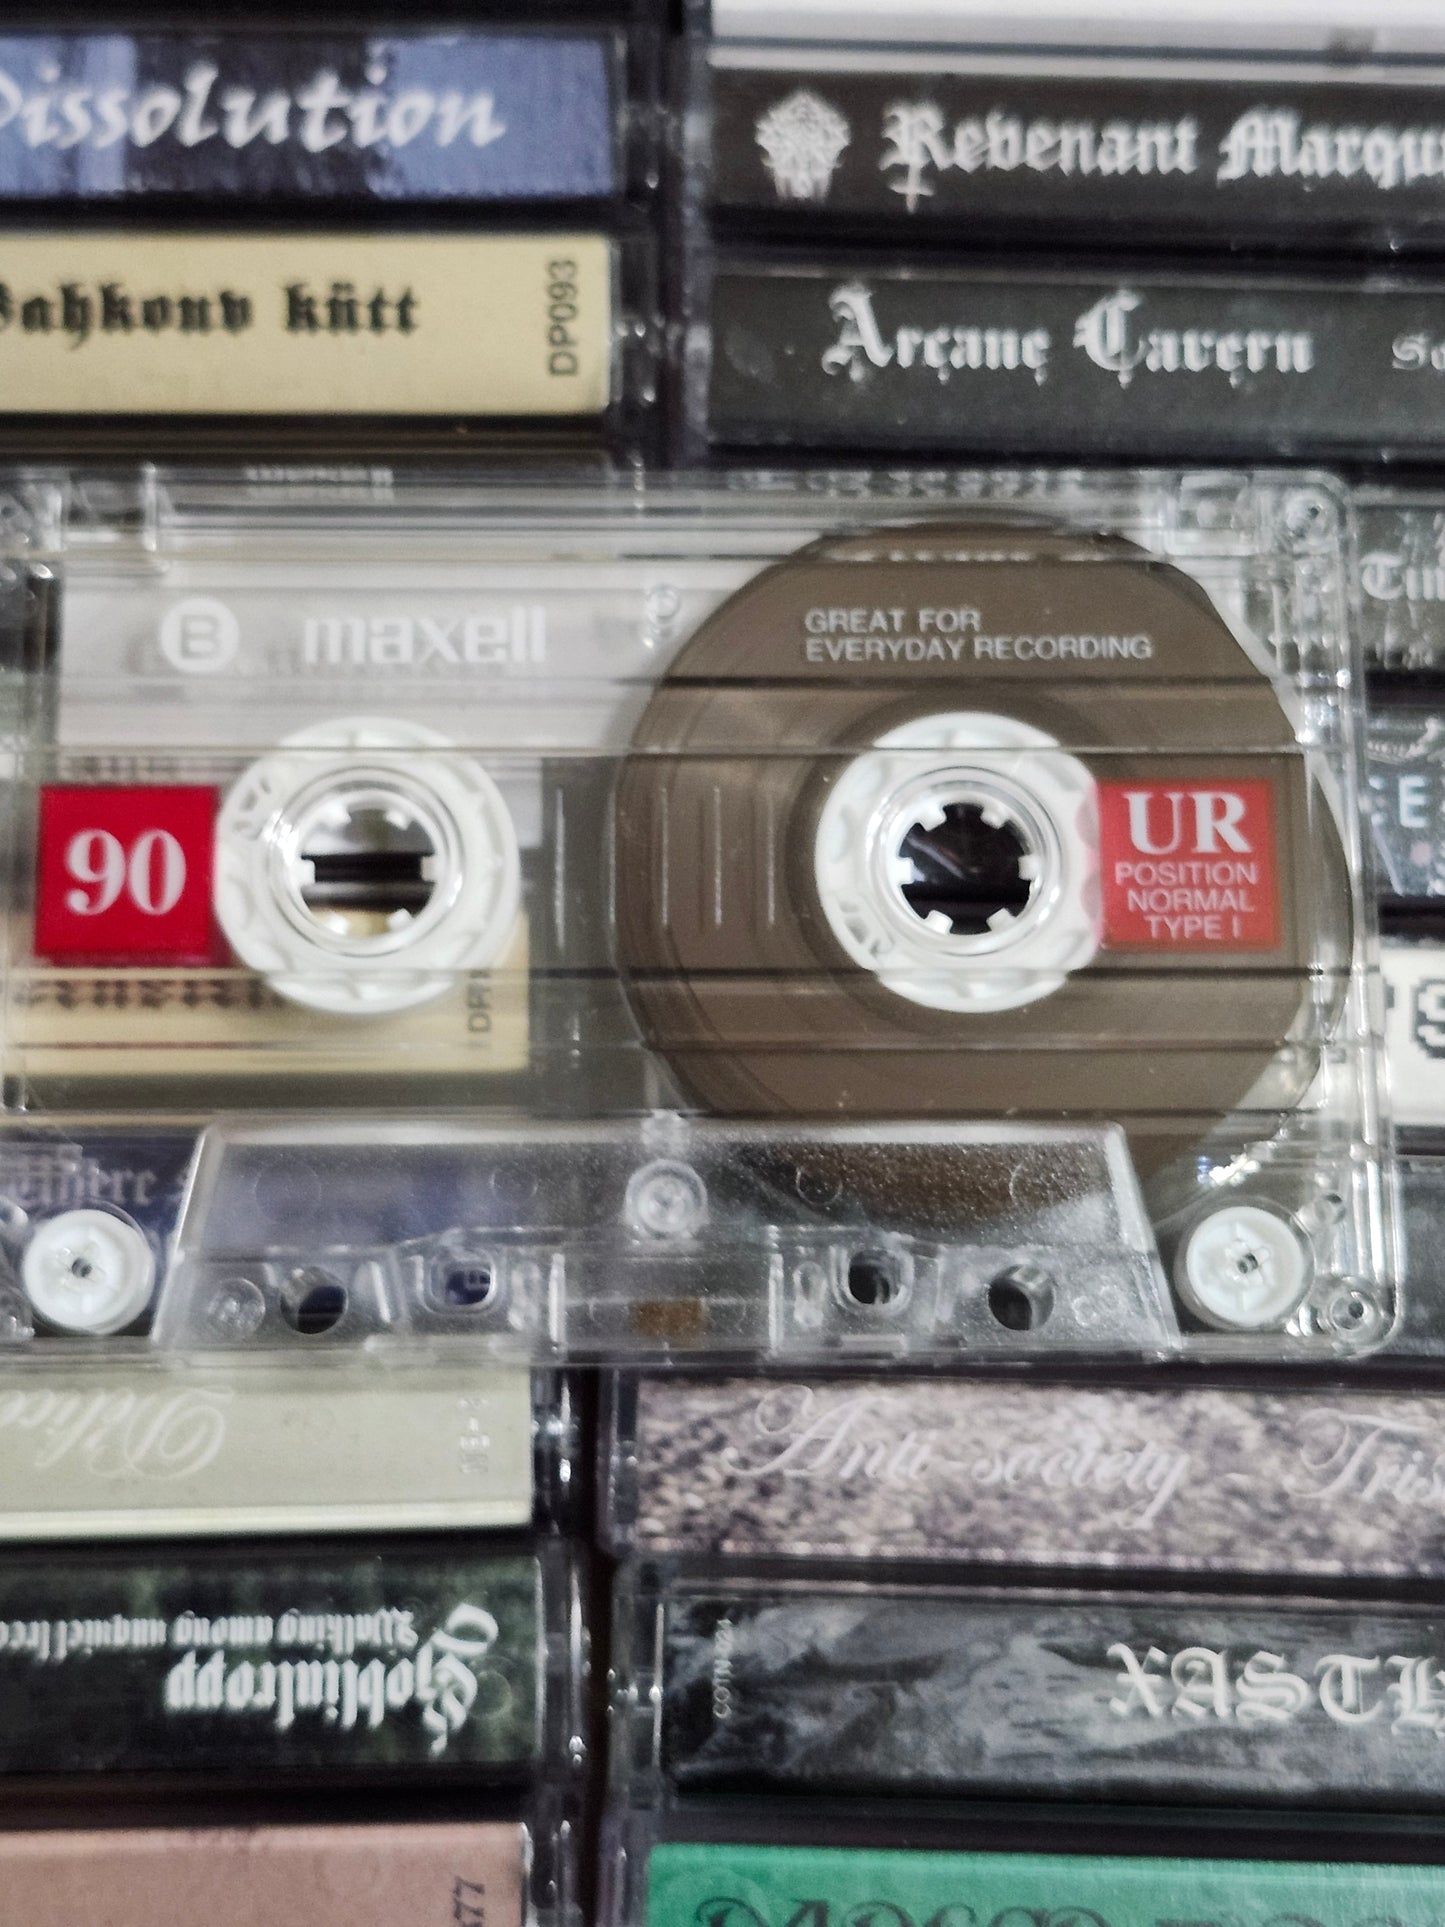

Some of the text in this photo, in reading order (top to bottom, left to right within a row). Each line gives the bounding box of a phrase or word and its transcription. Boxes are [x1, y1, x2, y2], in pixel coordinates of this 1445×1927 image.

[878, 97, 1445, 212] Revenant Marqu
[548, 259, 578, 376] DP093
[821, 284, 1314, 389] Arcane Cavern
[304, 605, 547, 664] maxell
[805, 607, 982, 633] GREAT FOR
[805, 635, 1153, 662] EVERYDAY RECORDING
[1122, 790, 1253, 856] UR
[65, 828, 187, 917] 90
[1114, 861, 1260, 887] POSITION
[1127, 888, 1255, 914] NORMAL
[1144, 914, 1224, 940] TYPE
[453, 1877, 484, 1927] 77
